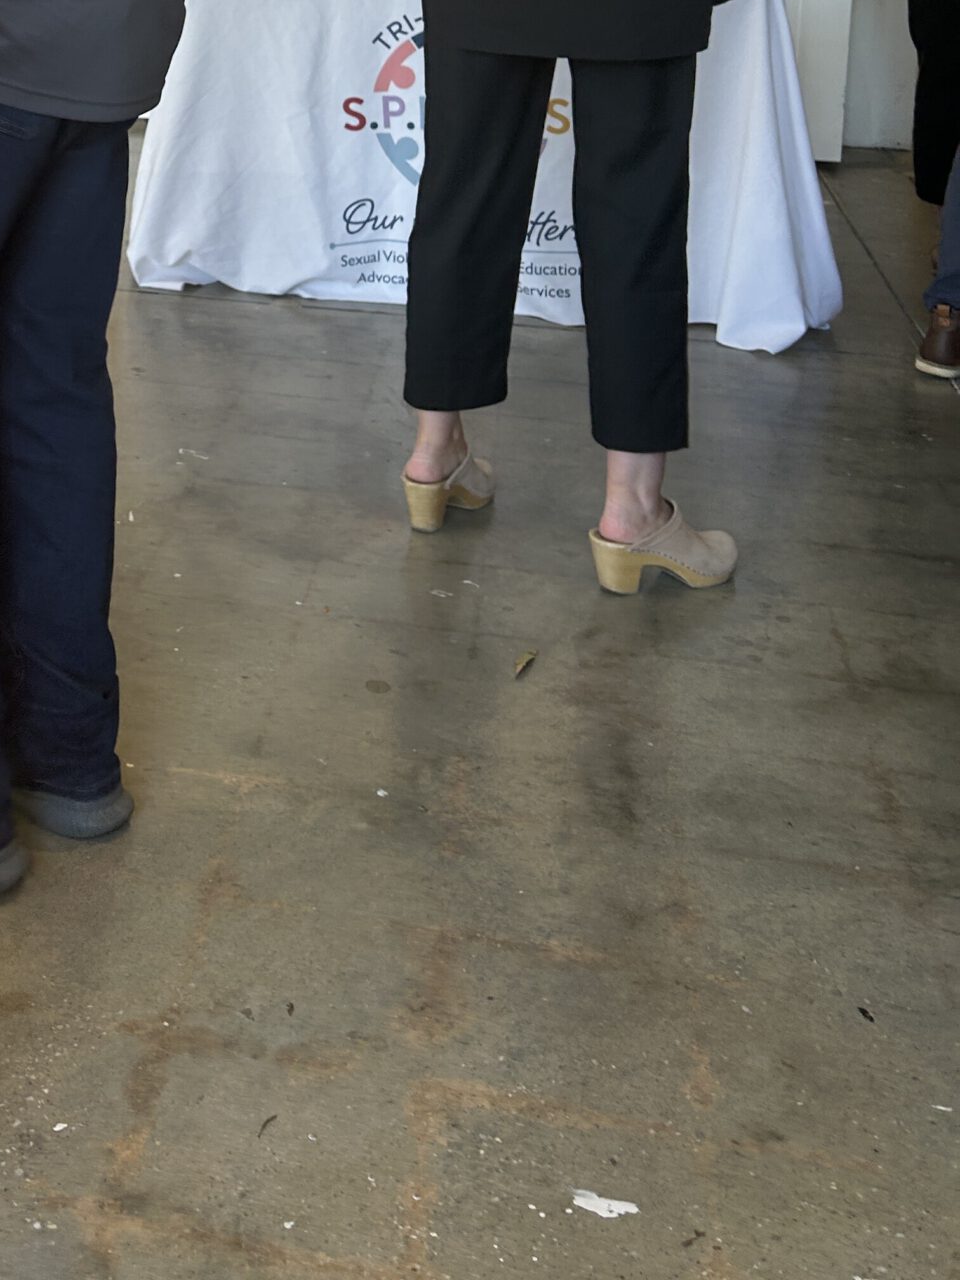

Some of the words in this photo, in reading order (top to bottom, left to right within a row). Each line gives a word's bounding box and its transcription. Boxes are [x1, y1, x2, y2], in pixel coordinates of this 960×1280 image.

[342, 95, 426, 132] S.P.
[342, 198, 404, 235] Our
[341, 250, 380, 267] Sexual
[357, 271, 408, 284] Advoca
